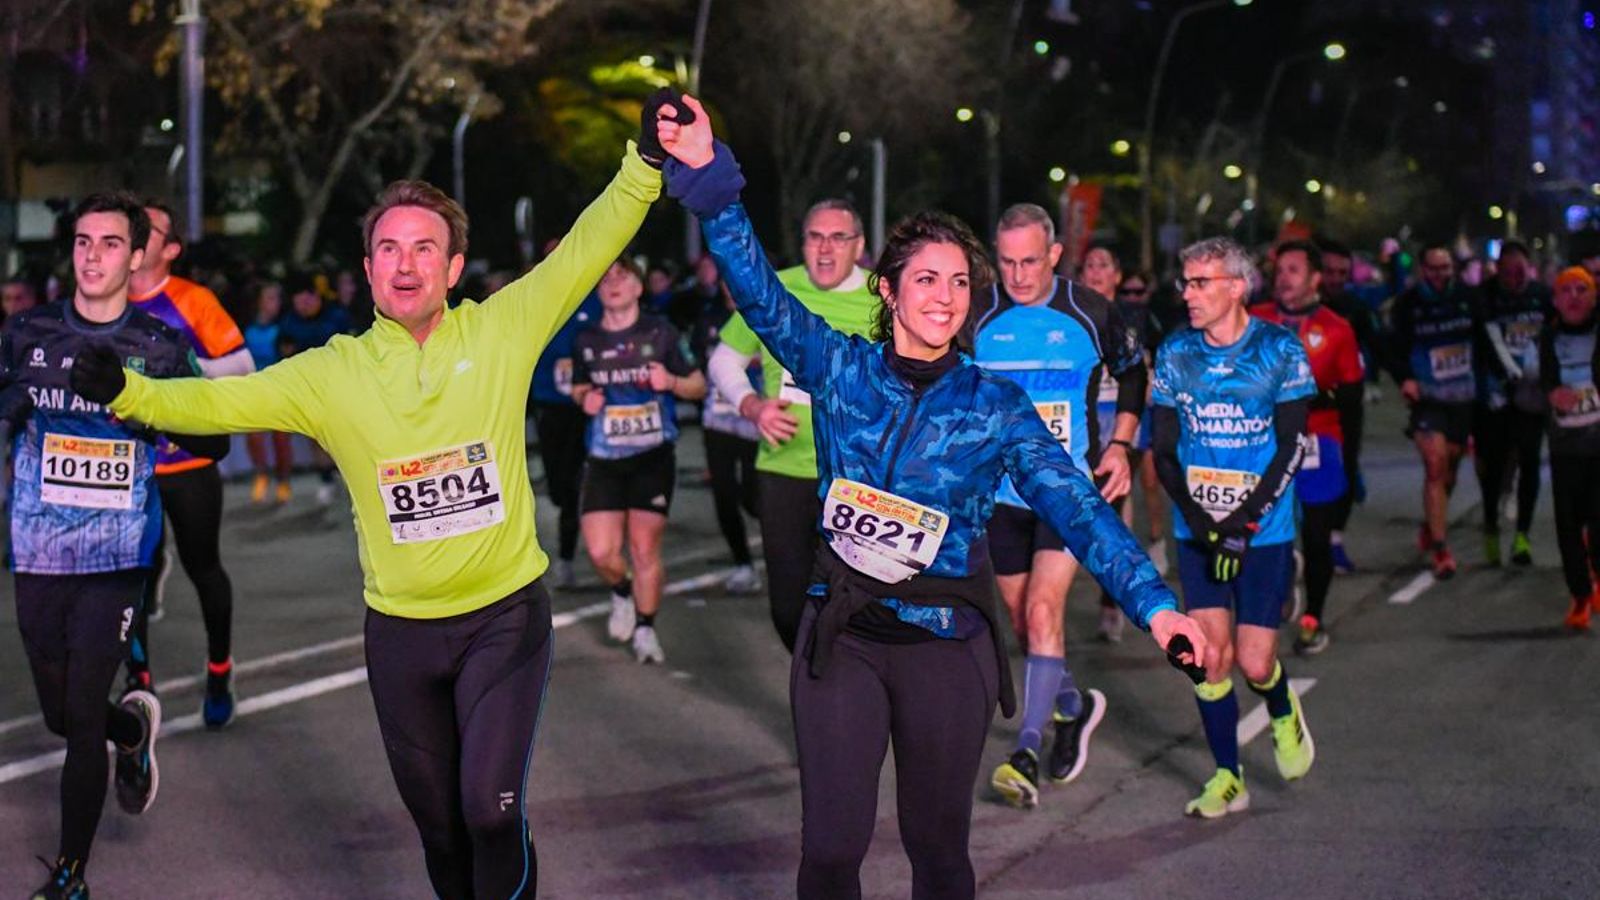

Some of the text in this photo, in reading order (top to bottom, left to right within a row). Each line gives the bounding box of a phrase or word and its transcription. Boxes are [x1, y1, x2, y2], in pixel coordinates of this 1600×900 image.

[612, 364, 650, 383] ANTÓ
[28, 386, 64, 410] SAN
[1196, 403, 1245, 418] MEDIA
[1199, 414, 1273, 434] MARATÓN
[46, 456, 130, 481] 10189
[400, 461, 422, 476] 42
[391, 466, 490, 512] 8504
[856, 490, 878, 508] 42
[832, 503, 925, 553] 8621
